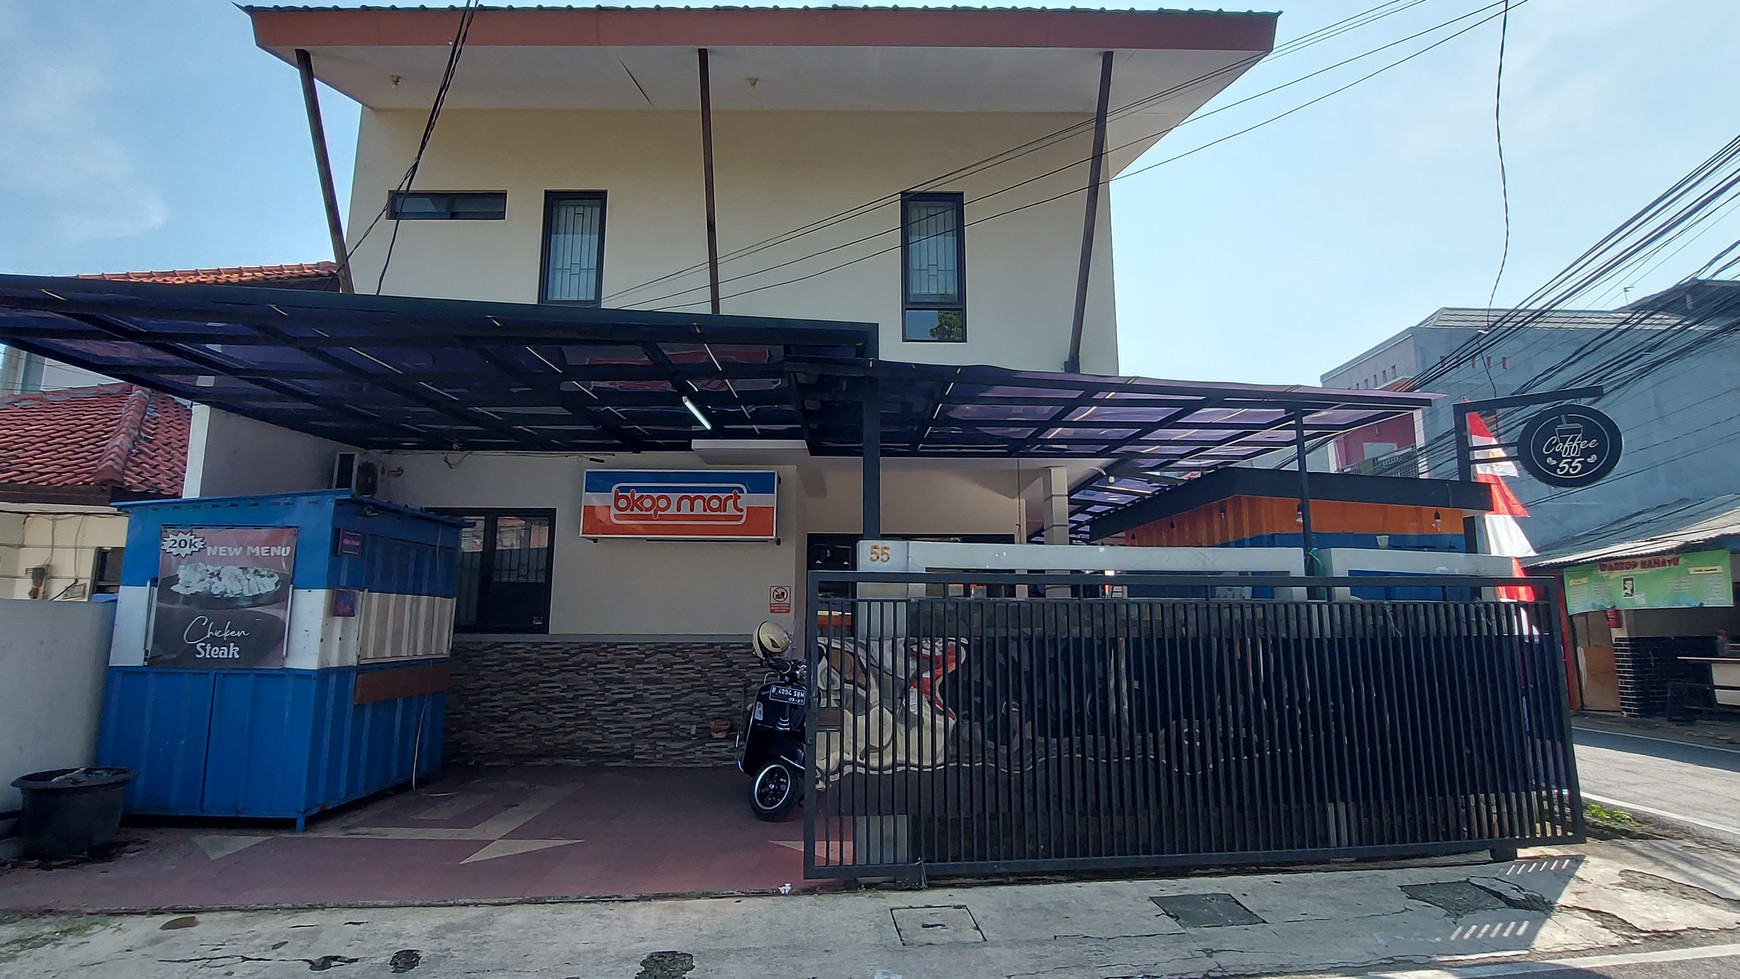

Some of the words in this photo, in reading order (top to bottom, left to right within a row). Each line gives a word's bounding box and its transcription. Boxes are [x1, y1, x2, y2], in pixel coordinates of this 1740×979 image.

[1542, 433, 1599, 457] Coffee
[1556, 458, 1585, 475] 55
[613, 488, 672, 519] bkop
[676, 489, 745, 513] mart
[169, 539, 199, 549] 20k
[206, 545, 243, 557] NEW
[246, 545, 291, 557] MENU
[869, 544, 890, 563] 55
[183, 615, 250, 645] Chicken
[195, 642, 240, 659] Steak
